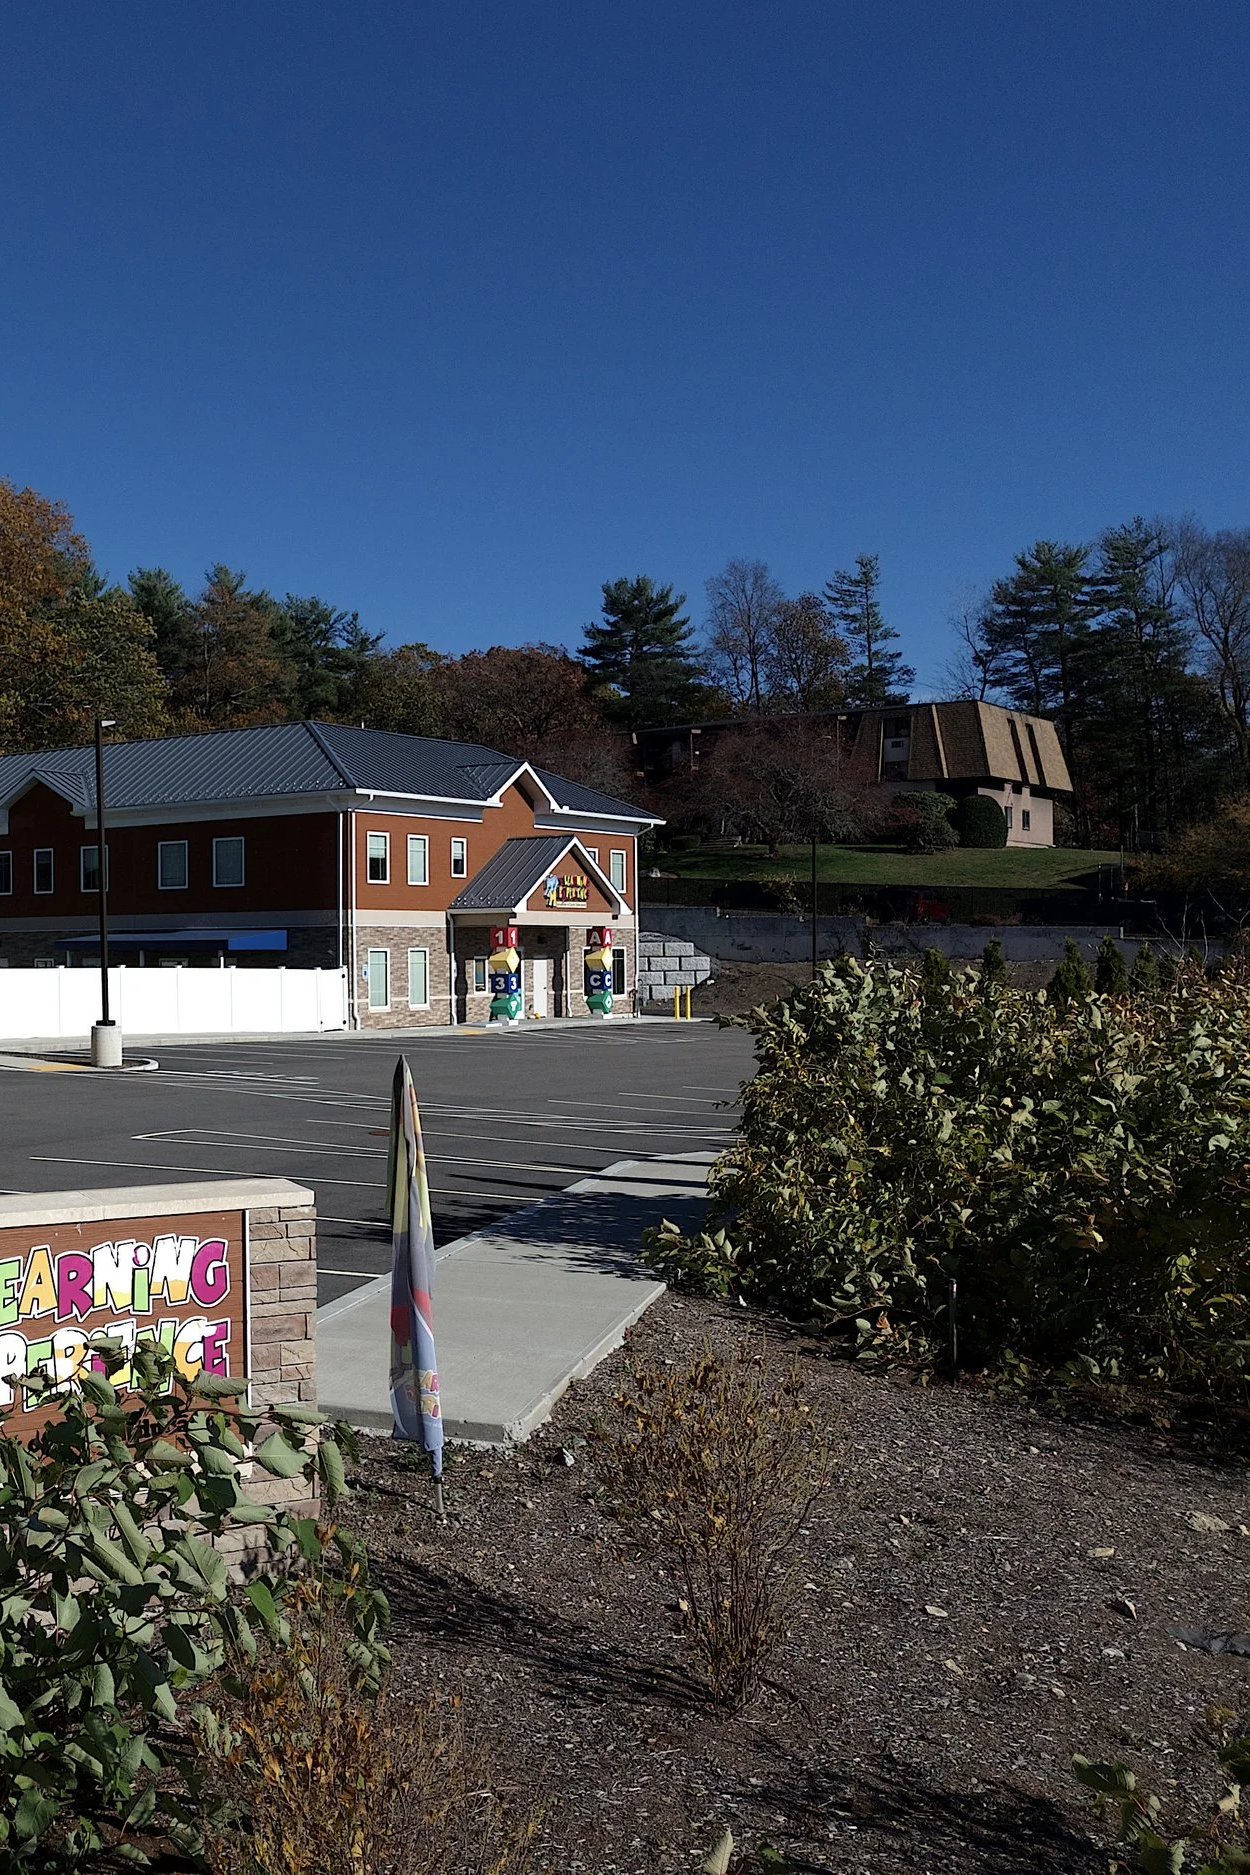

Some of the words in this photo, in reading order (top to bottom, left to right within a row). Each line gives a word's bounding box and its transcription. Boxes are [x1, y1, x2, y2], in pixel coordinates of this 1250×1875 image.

[495, 930, 503, 944] 1
[510, 930, 516, 944] 1
[590, 931, 601, 944] A
[604, 931, 612, 944] A
[495, 977, 505, 990] 3
[510, 977, 517, 990] 3
[590, 974, 601, 986] C
[605, 974, 612, 986] C
